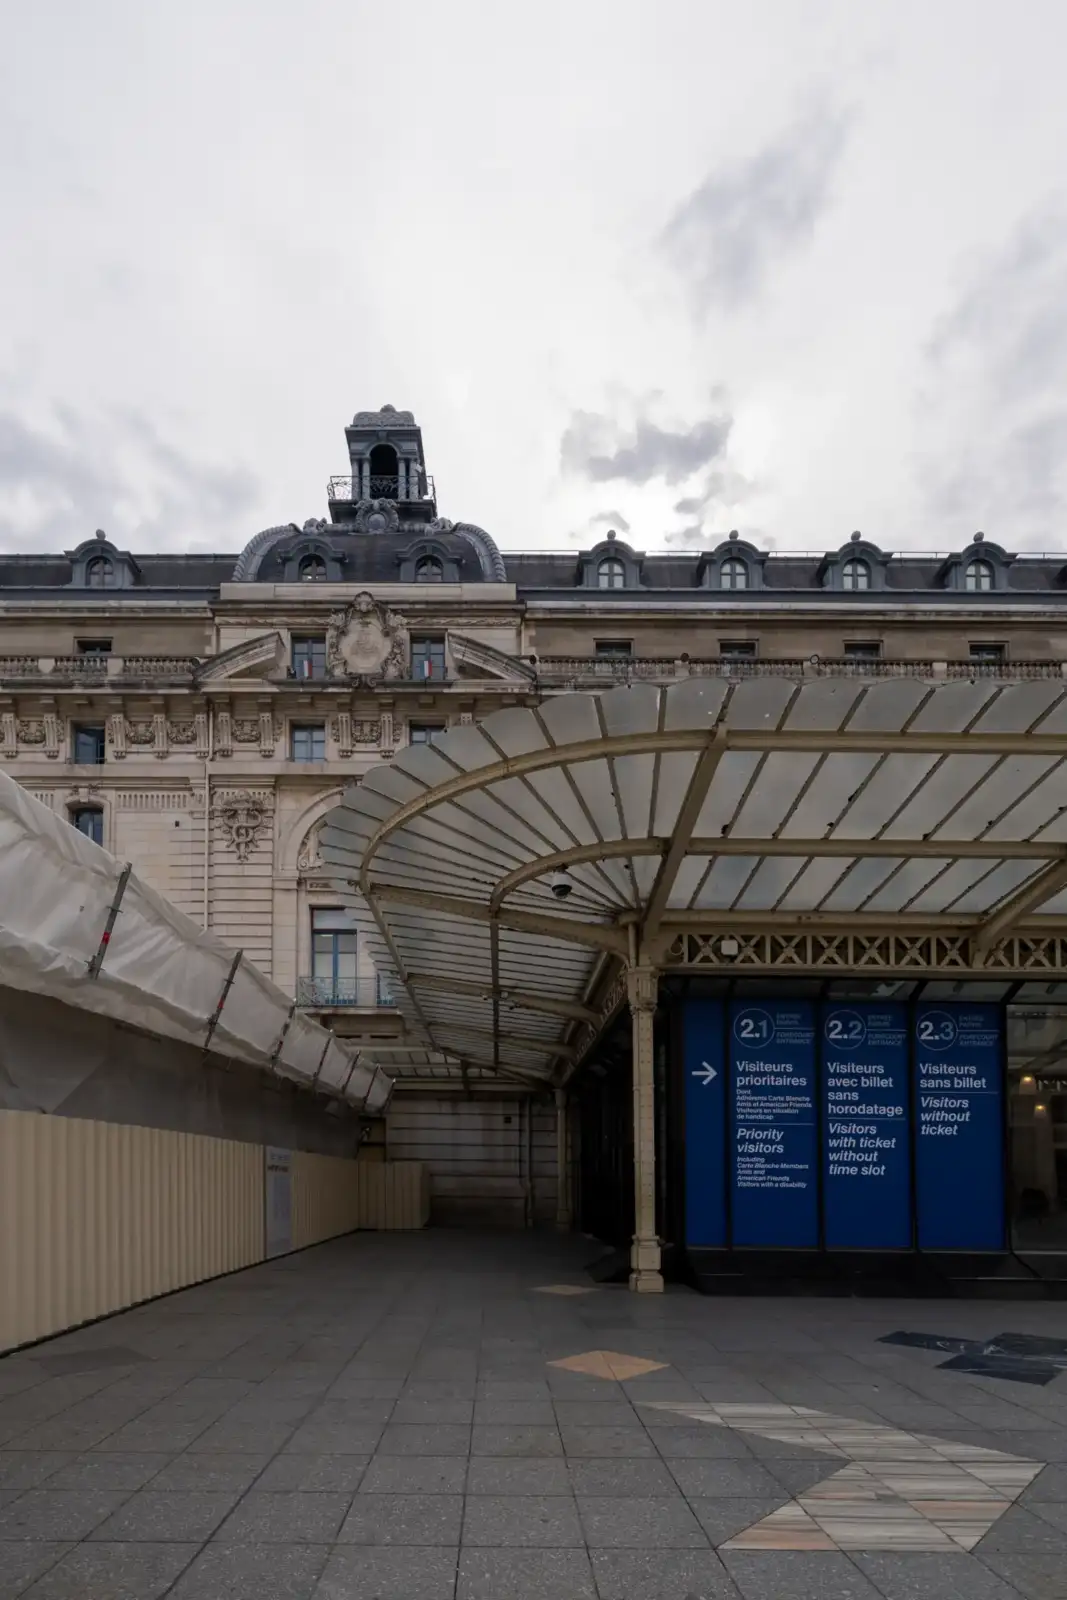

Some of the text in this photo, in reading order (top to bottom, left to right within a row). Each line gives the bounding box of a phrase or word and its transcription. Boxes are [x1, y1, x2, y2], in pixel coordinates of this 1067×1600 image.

[740, 1018, 768, 1038] 2.1
[828, 1020, 862, 1038] 2.2
[920, 1021, 954, 1040] 2.3
[736, 1060, 793, 1072] Visiteurs
[827, 1062, 884, 1074] Visiteurs
[920, 1063, 976, 1074] Visiteurs
[736, 1074, 807, 1087] prioritaires
[828, 1076, 894, 1087] avec billet
[920, 1077, 986, 1088] sans billet
[828, 1092, 859, 1100] sans
[920, 1096, 969, 1108] Visitors
[828, 1103, 903, 1116] horodatage
[920, 1110, 970, 1122] without
[829, 1123, 876, 1134] Visitors
[921, 1124, 958, 1135] ticket
[736, 1128, 784, 1142] Priority
[738, 1142, 784, 1153] visitors
[829, 1136, 896, 1148] with ticket
[829, 1150, 878, 1162] without
[829, 1164, 886, 1176] time slot
